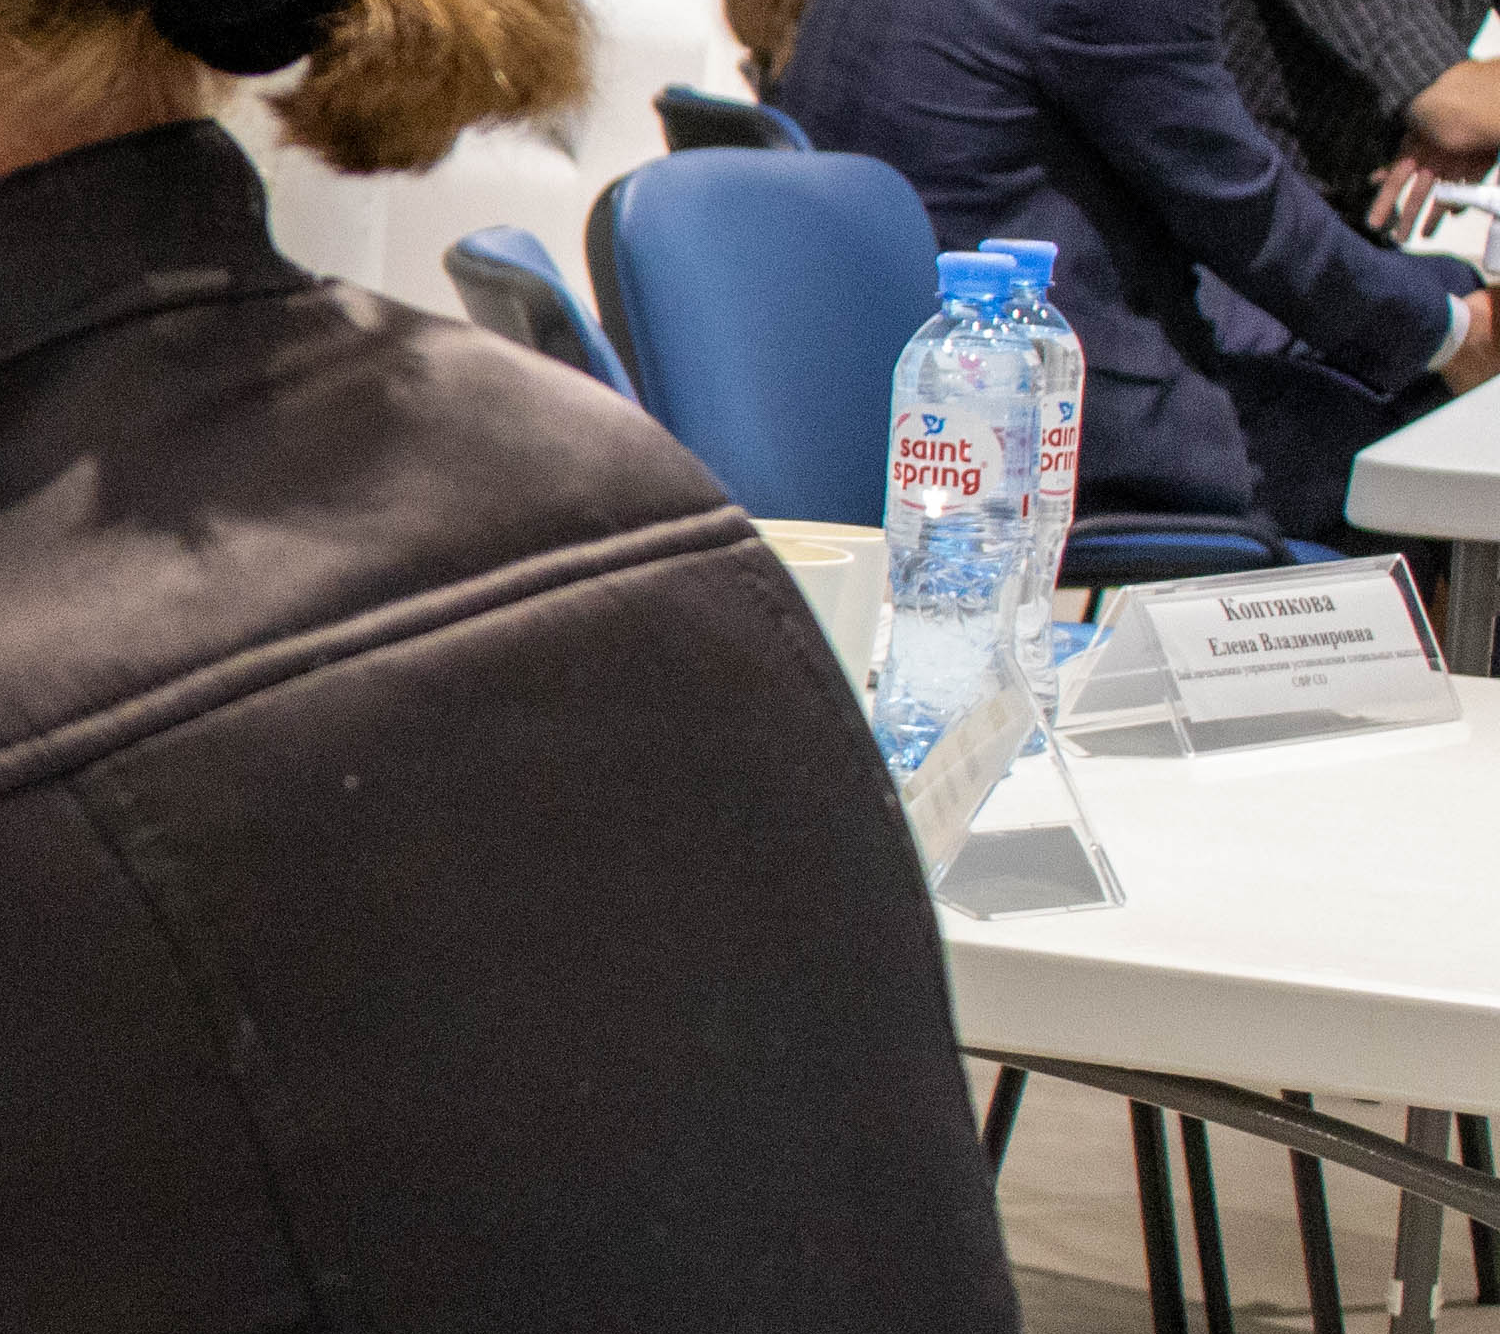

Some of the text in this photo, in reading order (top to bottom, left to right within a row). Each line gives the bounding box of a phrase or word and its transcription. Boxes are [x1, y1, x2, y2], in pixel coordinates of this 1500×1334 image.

[900, 437, 973, 464] saint
[893, 461, 981, 496] spring
[1218, 593, 1336, 621] Коптякова
[1207, 625, 1375, 657] Елена Владимировна
